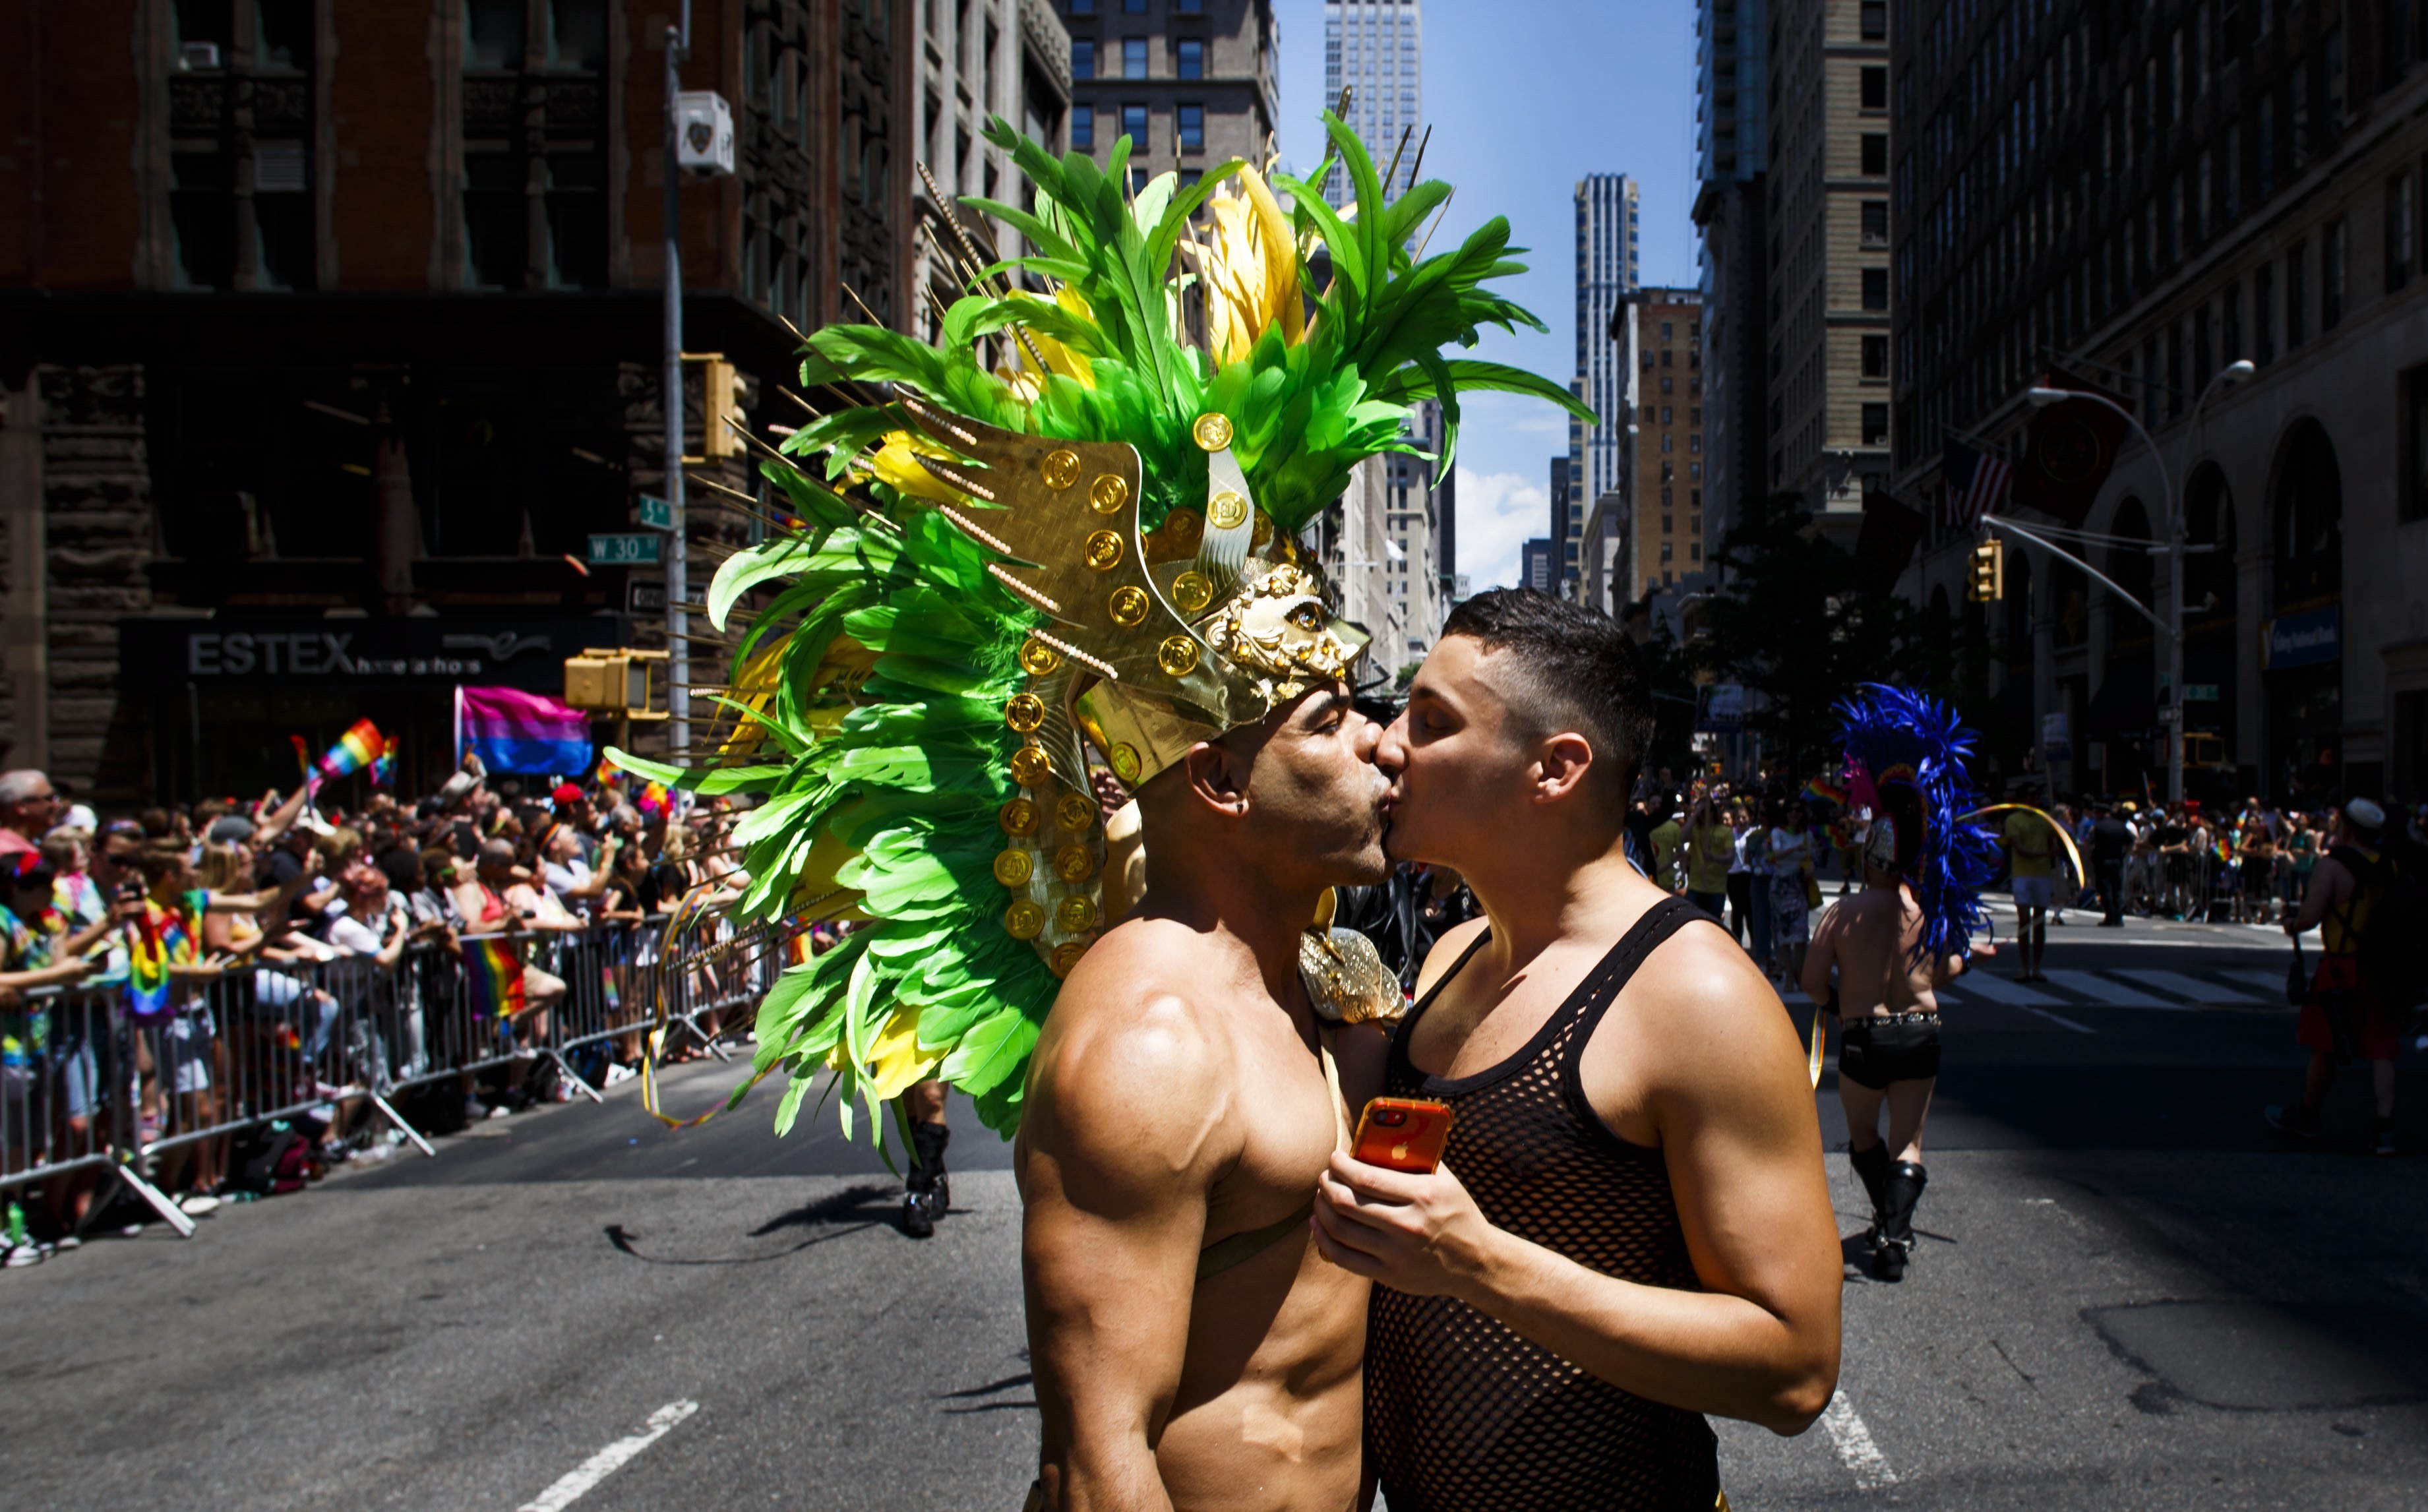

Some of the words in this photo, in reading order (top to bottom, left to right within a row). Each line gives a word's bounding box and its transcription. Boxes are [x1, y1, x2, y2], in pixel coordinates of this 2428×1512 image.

[646, 499, 655, 522] 5
[593, 538, 607, 558] W
[615, 537, 639, 559] 30
[187, 632, 356, 676] ESTEX
